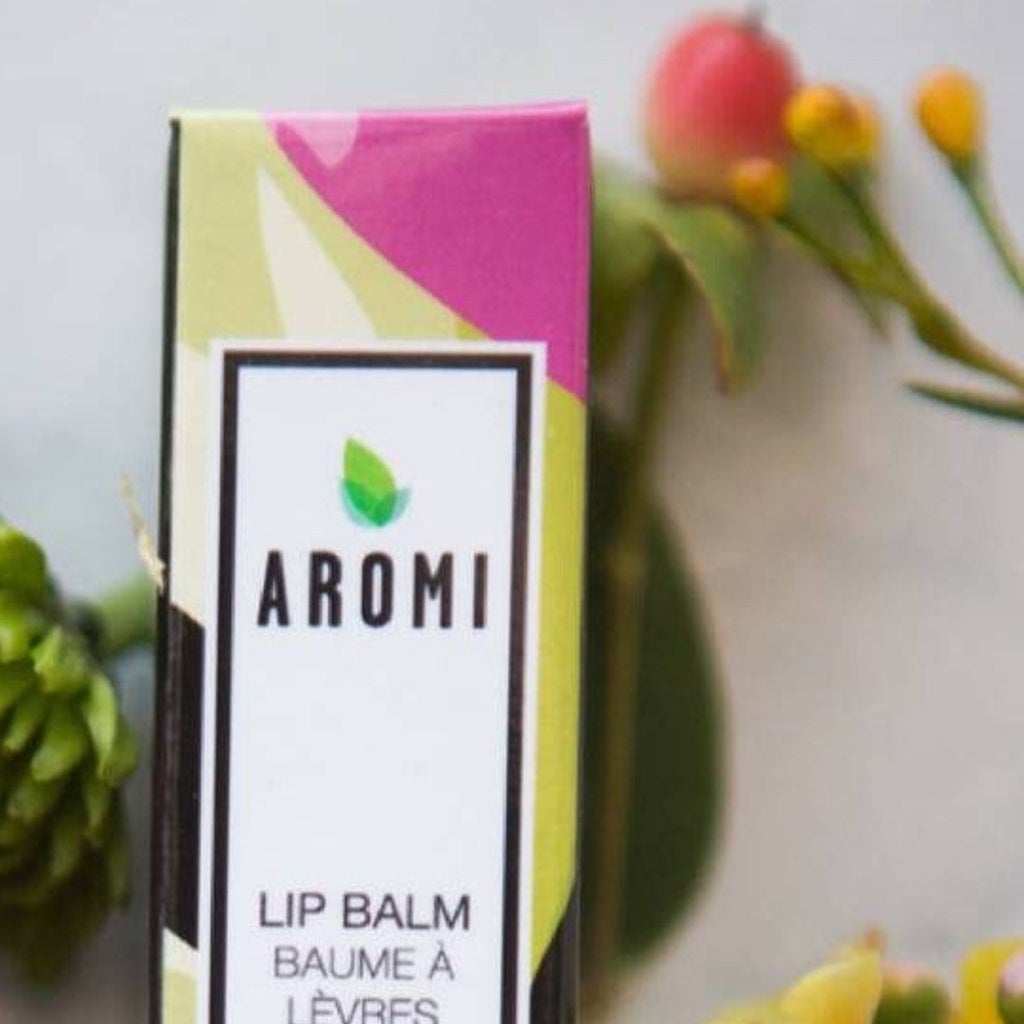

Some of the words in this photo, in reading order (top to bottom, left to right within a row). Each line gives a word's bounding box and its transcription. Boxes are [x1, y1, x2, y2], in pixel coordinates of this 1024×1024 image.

[257, 550, 489, 629] AROMI
[259, 891, 325, 928] LIP
[343, 893, 471, 931] BALM
[274, 946, 415, 980] BAUME
[428, 941, 454, 980] À
